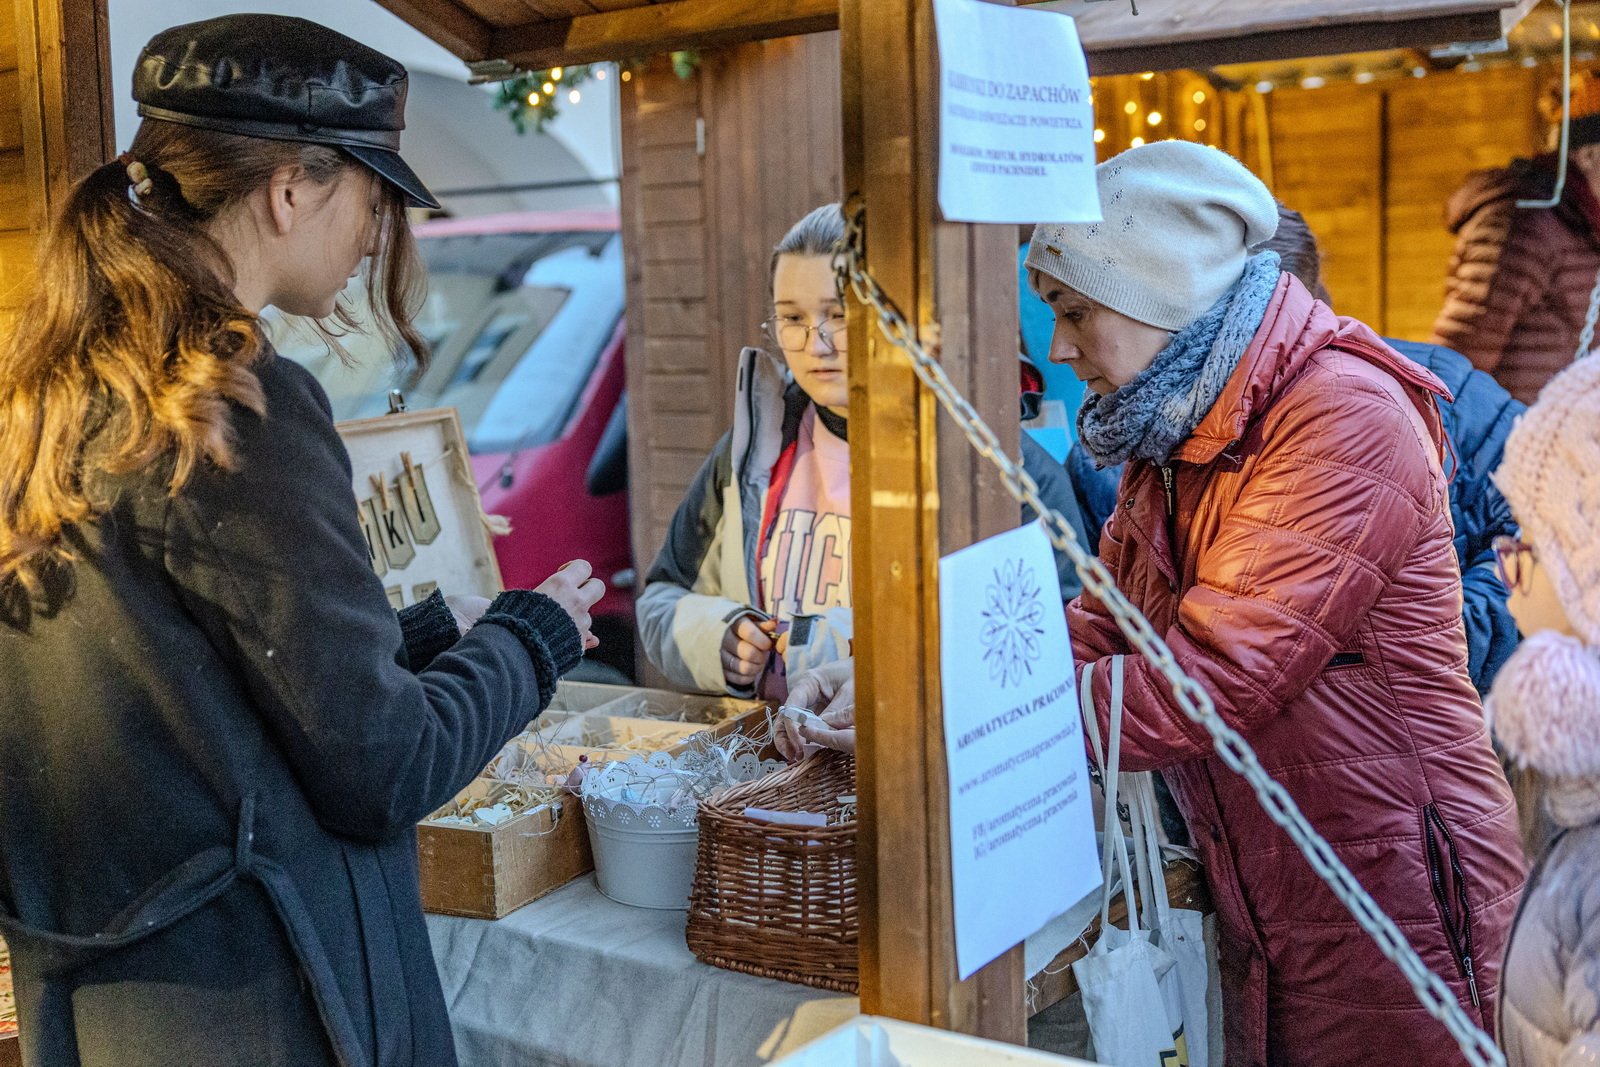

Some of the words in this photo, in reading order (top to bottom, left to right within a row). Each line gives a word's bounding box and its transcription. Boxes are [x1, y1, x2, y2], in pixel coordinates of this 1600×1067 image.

[988, 80, 1004, 98] DO
[1006, 84, 1082, 104] ZAPACHÓW
[1030, 115, 1083, 129] POWIETRZA
[956, 702, 1032, 752] AROMATYCZNA
